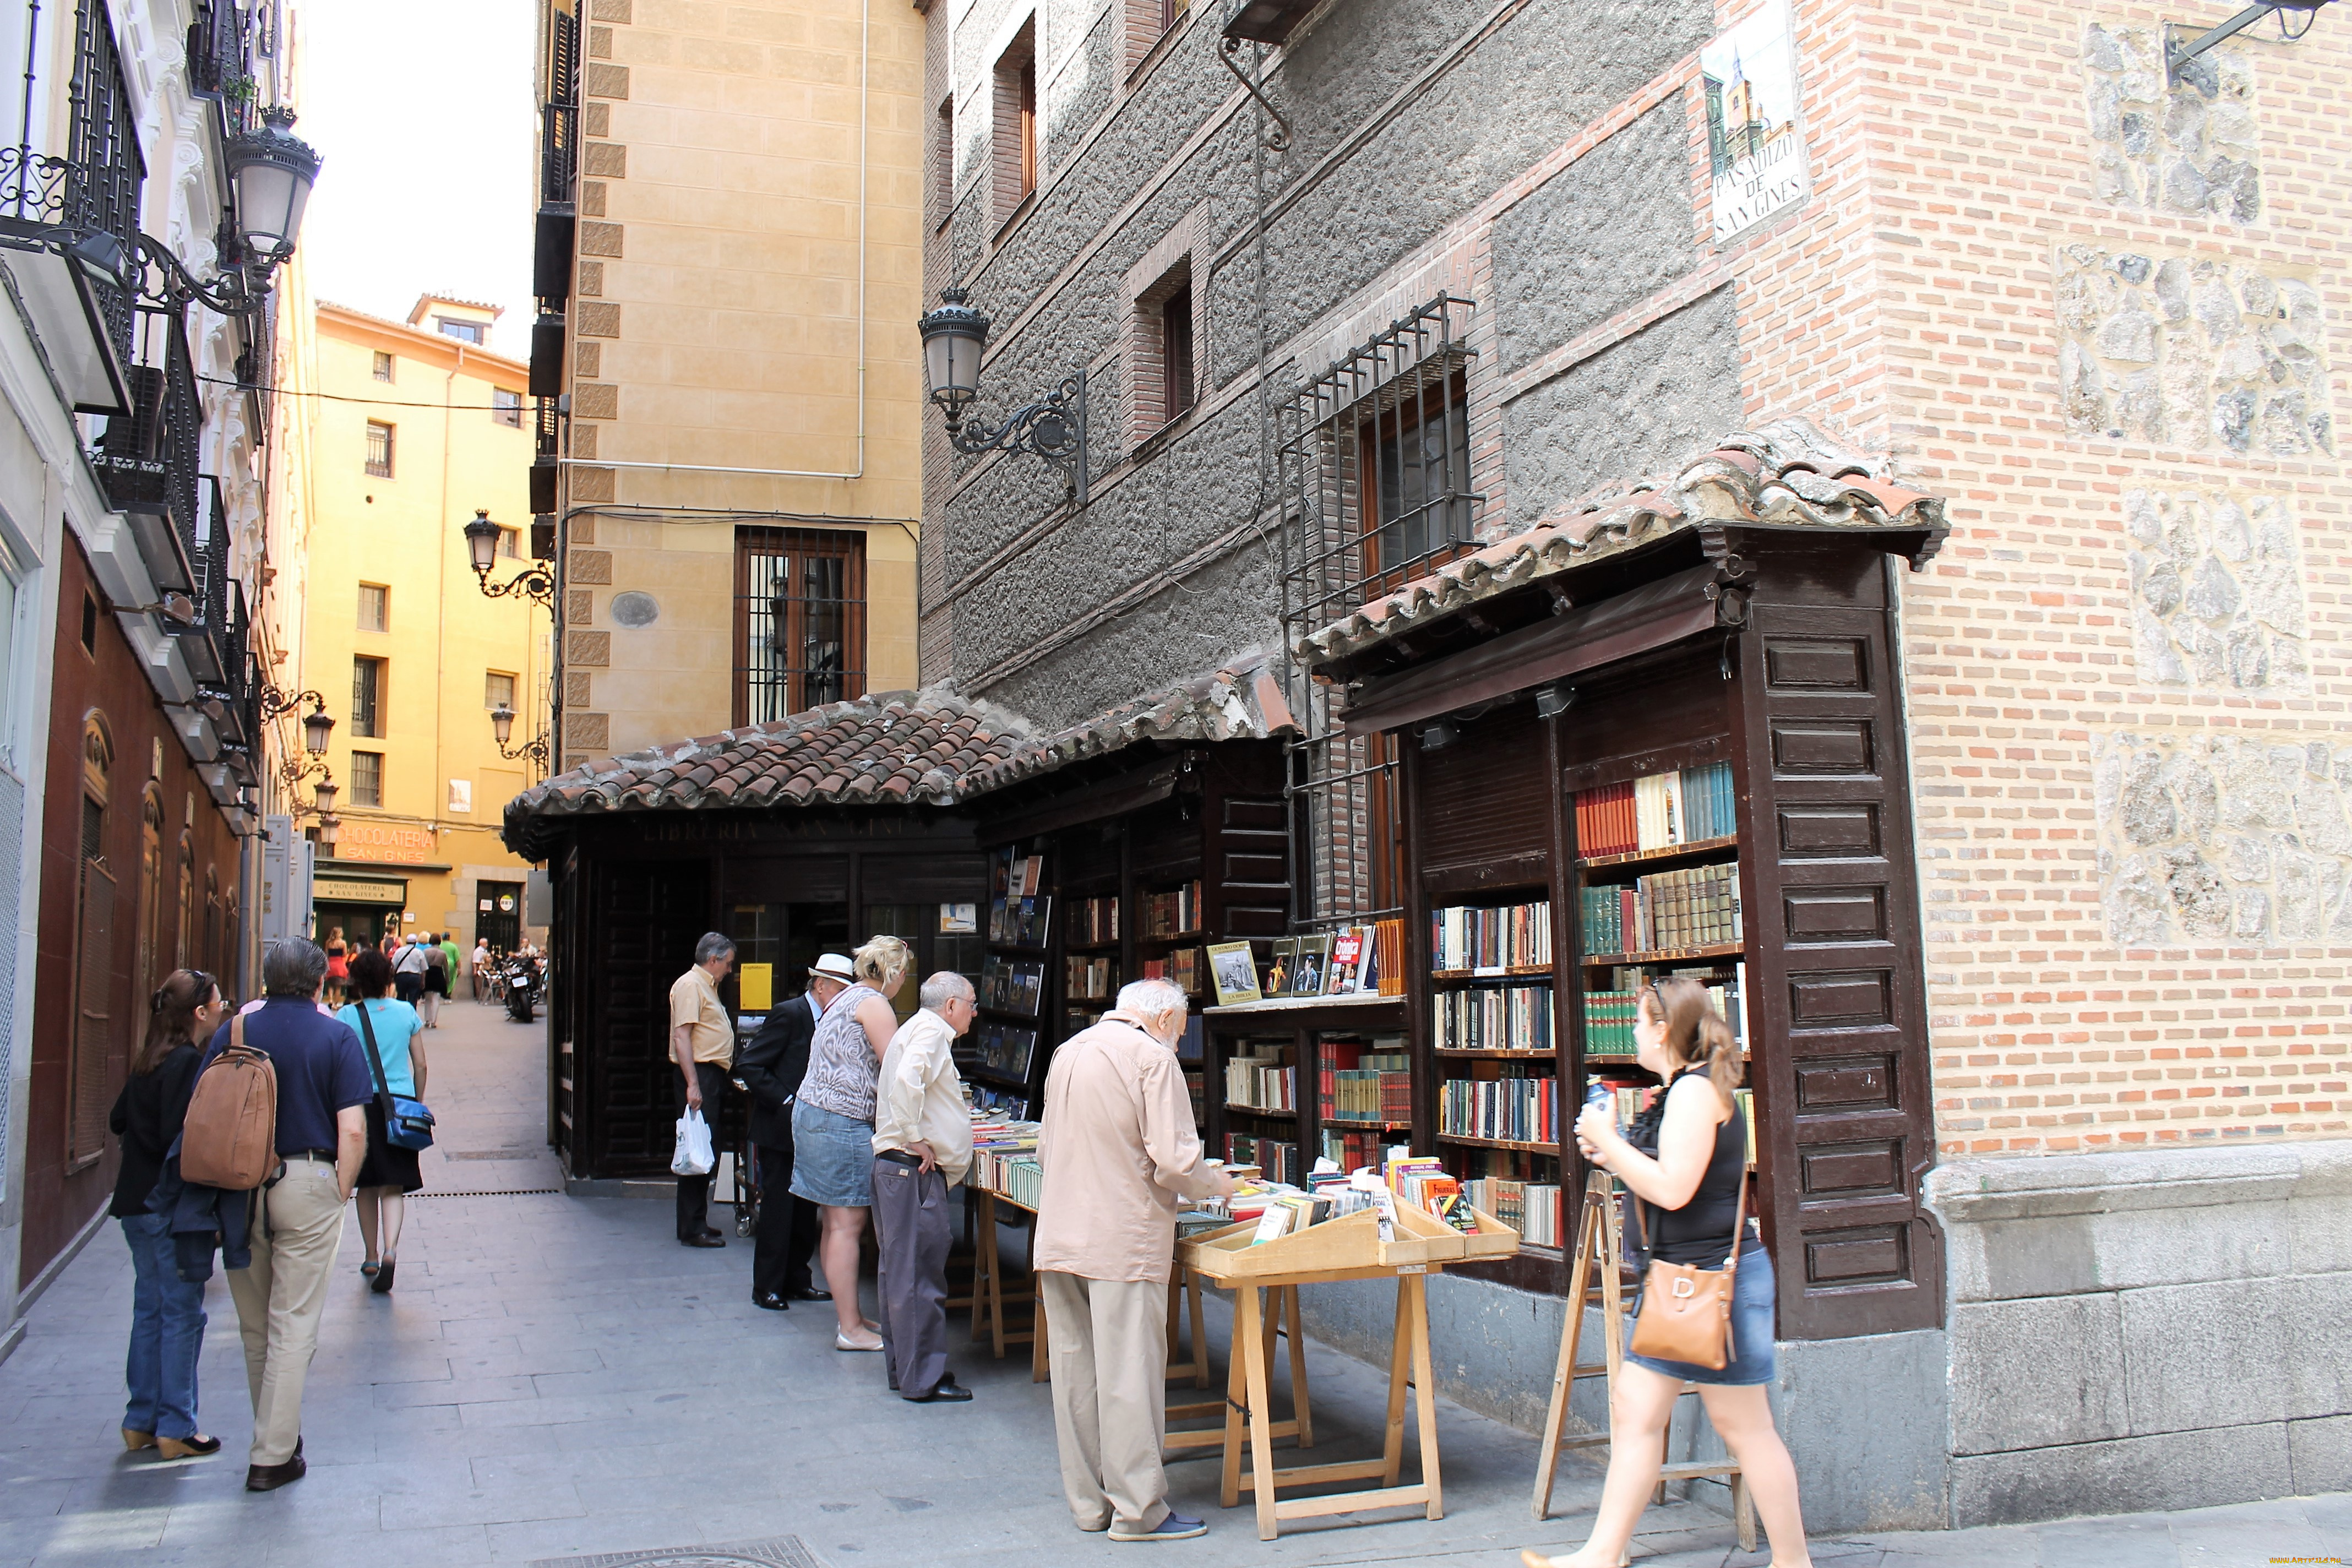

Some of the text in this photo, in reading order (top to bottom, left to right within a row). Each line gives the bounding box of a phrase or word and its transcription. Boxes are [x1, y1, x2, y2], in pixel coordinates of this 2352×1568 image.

[1716, 133, 1793, 197] PASADIZO
[1745, 174, 1765, 198] DE
[1715, 173, 1800, 240] SAN GINES
[337, 826, 434, 848] CHOCOLATERIA
[347, 848, 376, 859] SAN
[329, 883, 384, 891] CHOCOLATERIA
[1335, 939, 1359, 956] Crónica
[1672, 1277, 1695, 1298] D
